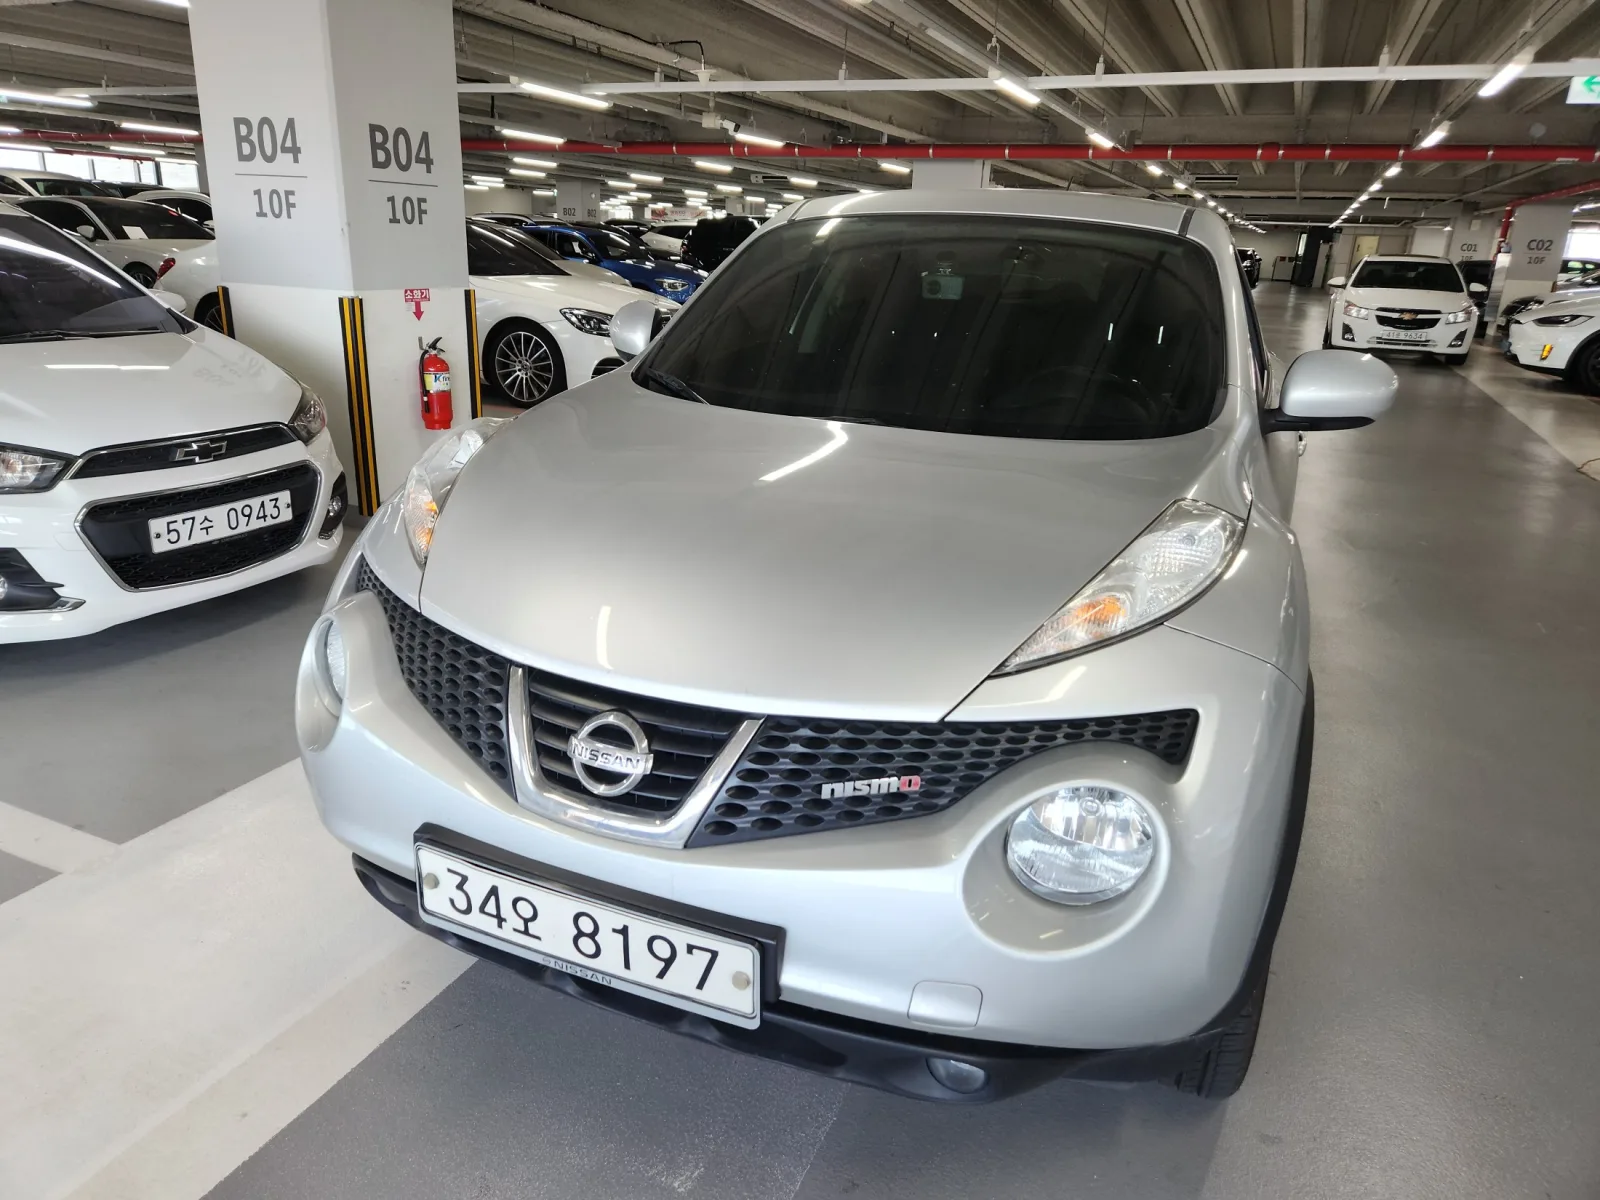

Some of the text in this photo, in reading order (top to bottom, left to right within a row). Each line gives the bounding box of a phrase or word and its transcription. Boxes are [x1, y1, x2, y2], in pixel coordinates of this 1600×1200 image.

[233, 117, 302, 164] B04
[368, 123, 434, 174] B04
[253, 188, 297, 219] 10F
[386, 195, 428, 225] 10F
[562, 207, 577, 217] B02
[587, 208, 597, 218] B02
[1460, 243, 1478, 253] C01
[1526, 239, 1553, 252] C02
[1526, 256, 1547, 265] 10F
[405, 289, 430, 299] 소화기
[166, 497, 281, 545] 57수 0943
[572, 739, 641, 769] NISSAN
[446, 867, 720, 991] 34오 8197
[554, 960, 612, 986] NISSAN
